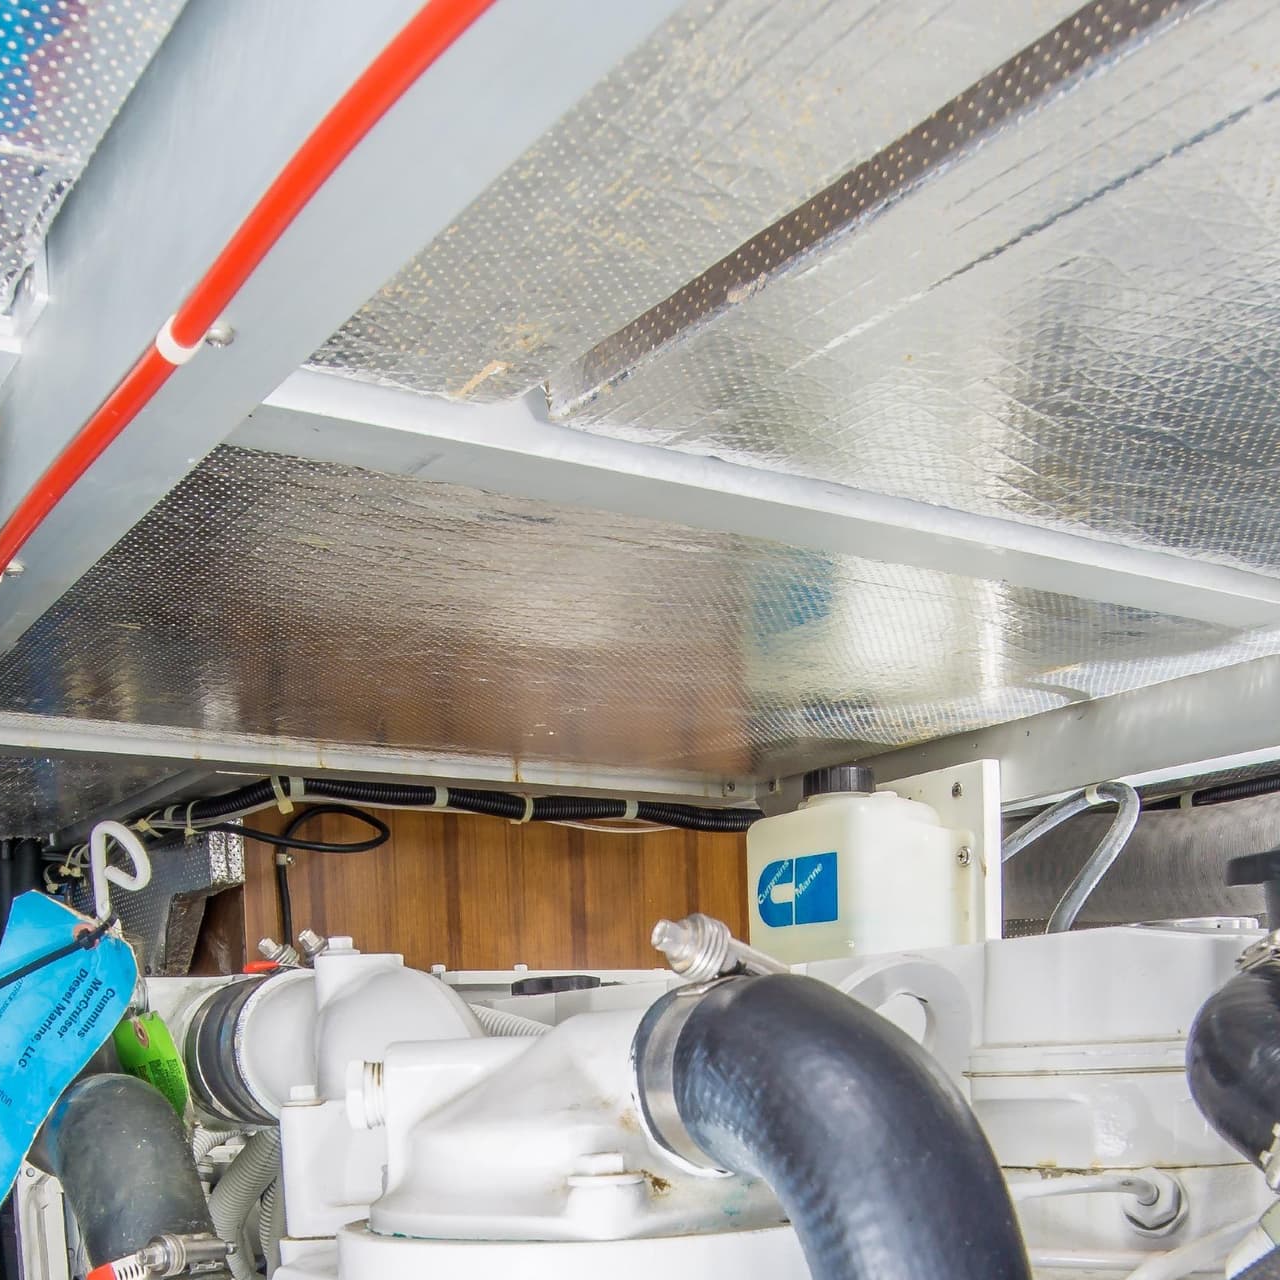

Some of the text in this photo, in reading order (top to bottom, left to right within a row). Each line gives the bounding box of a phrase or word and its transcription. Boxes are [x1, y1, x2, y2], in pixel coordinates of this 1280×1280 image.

[758, 861, 789, 905] Cummins
[795, 863, 823, 899] Marine
[18, 968, 89, 1068] Diesel Marine, LLC
[57, 977, 103, 1039] MerCruiser
[77, 988, 116, 1039] Cummins
